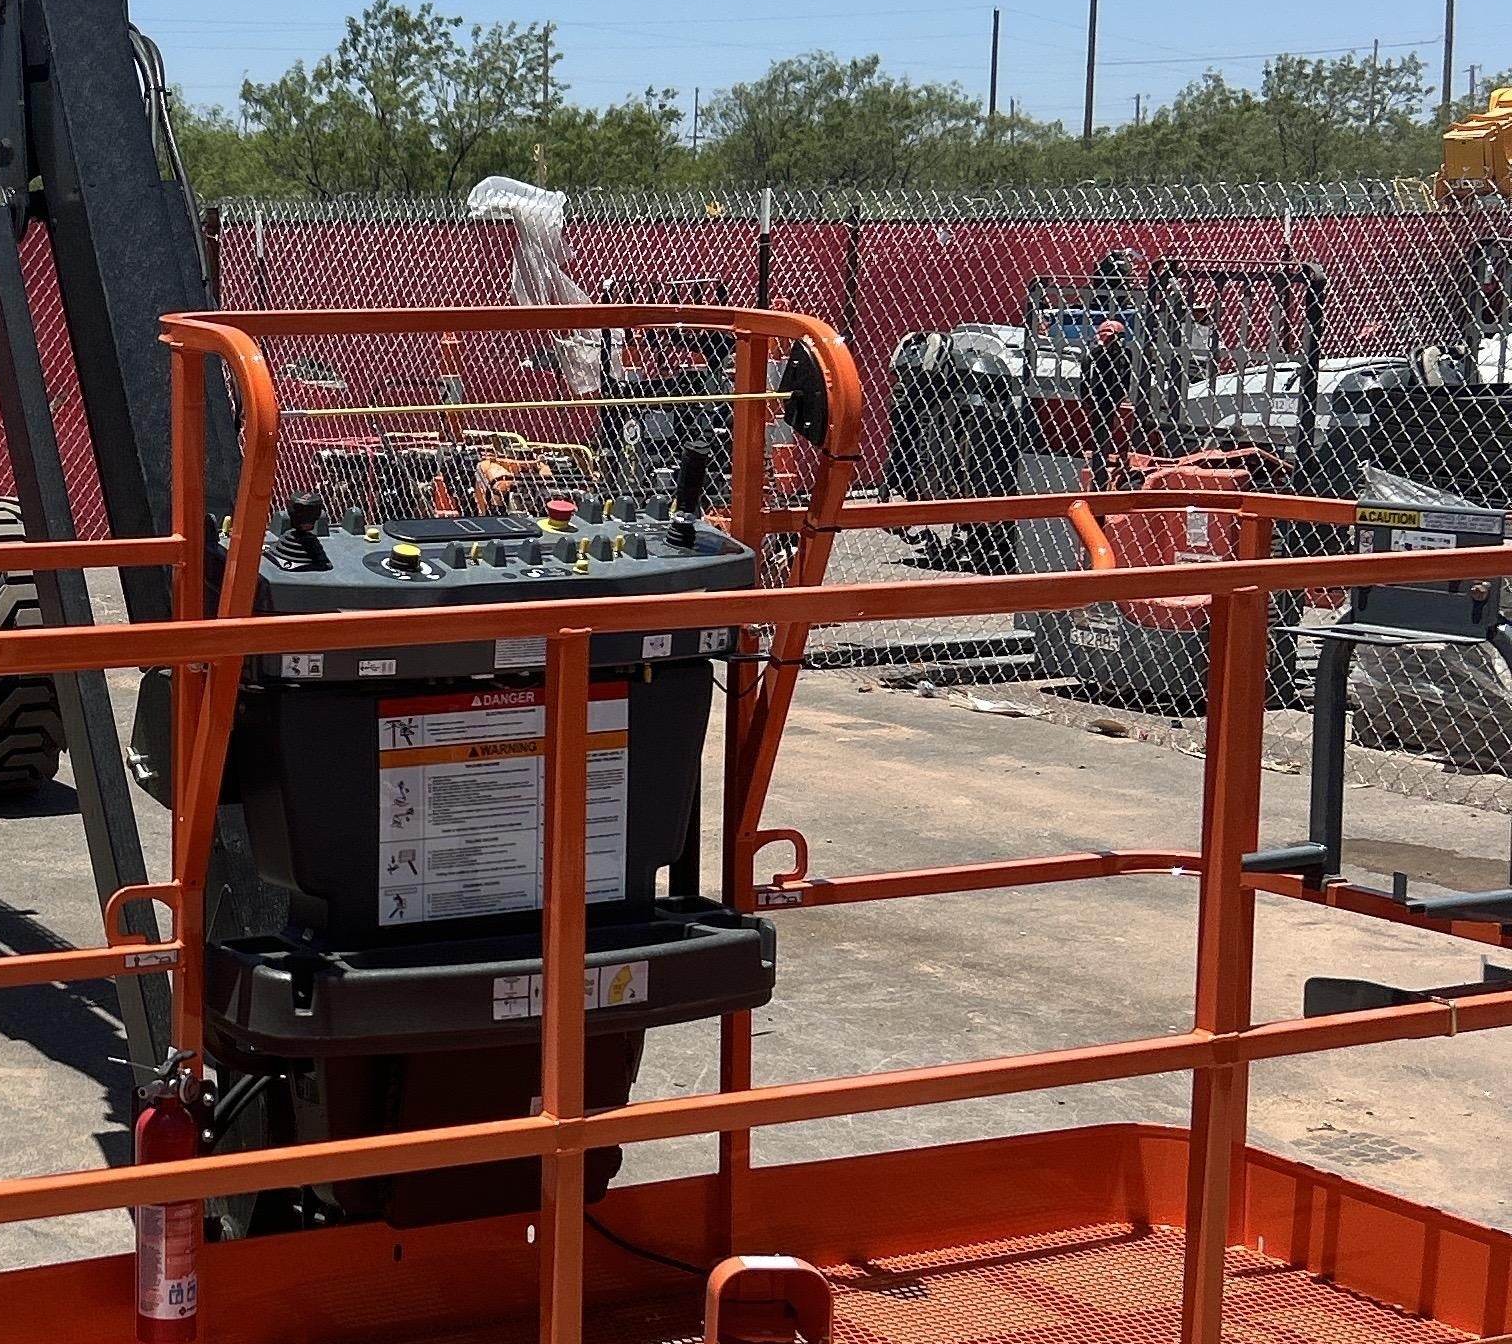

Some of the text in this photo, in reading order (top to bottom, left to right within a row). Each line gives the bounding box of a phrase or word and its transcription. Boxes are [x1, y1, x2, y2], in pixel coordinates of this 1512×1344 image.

[1368, 510, 1417, 525] CAUTION
[483, 691, 536, 707] DANGER
[478, 740, 538, 757] WARNING
